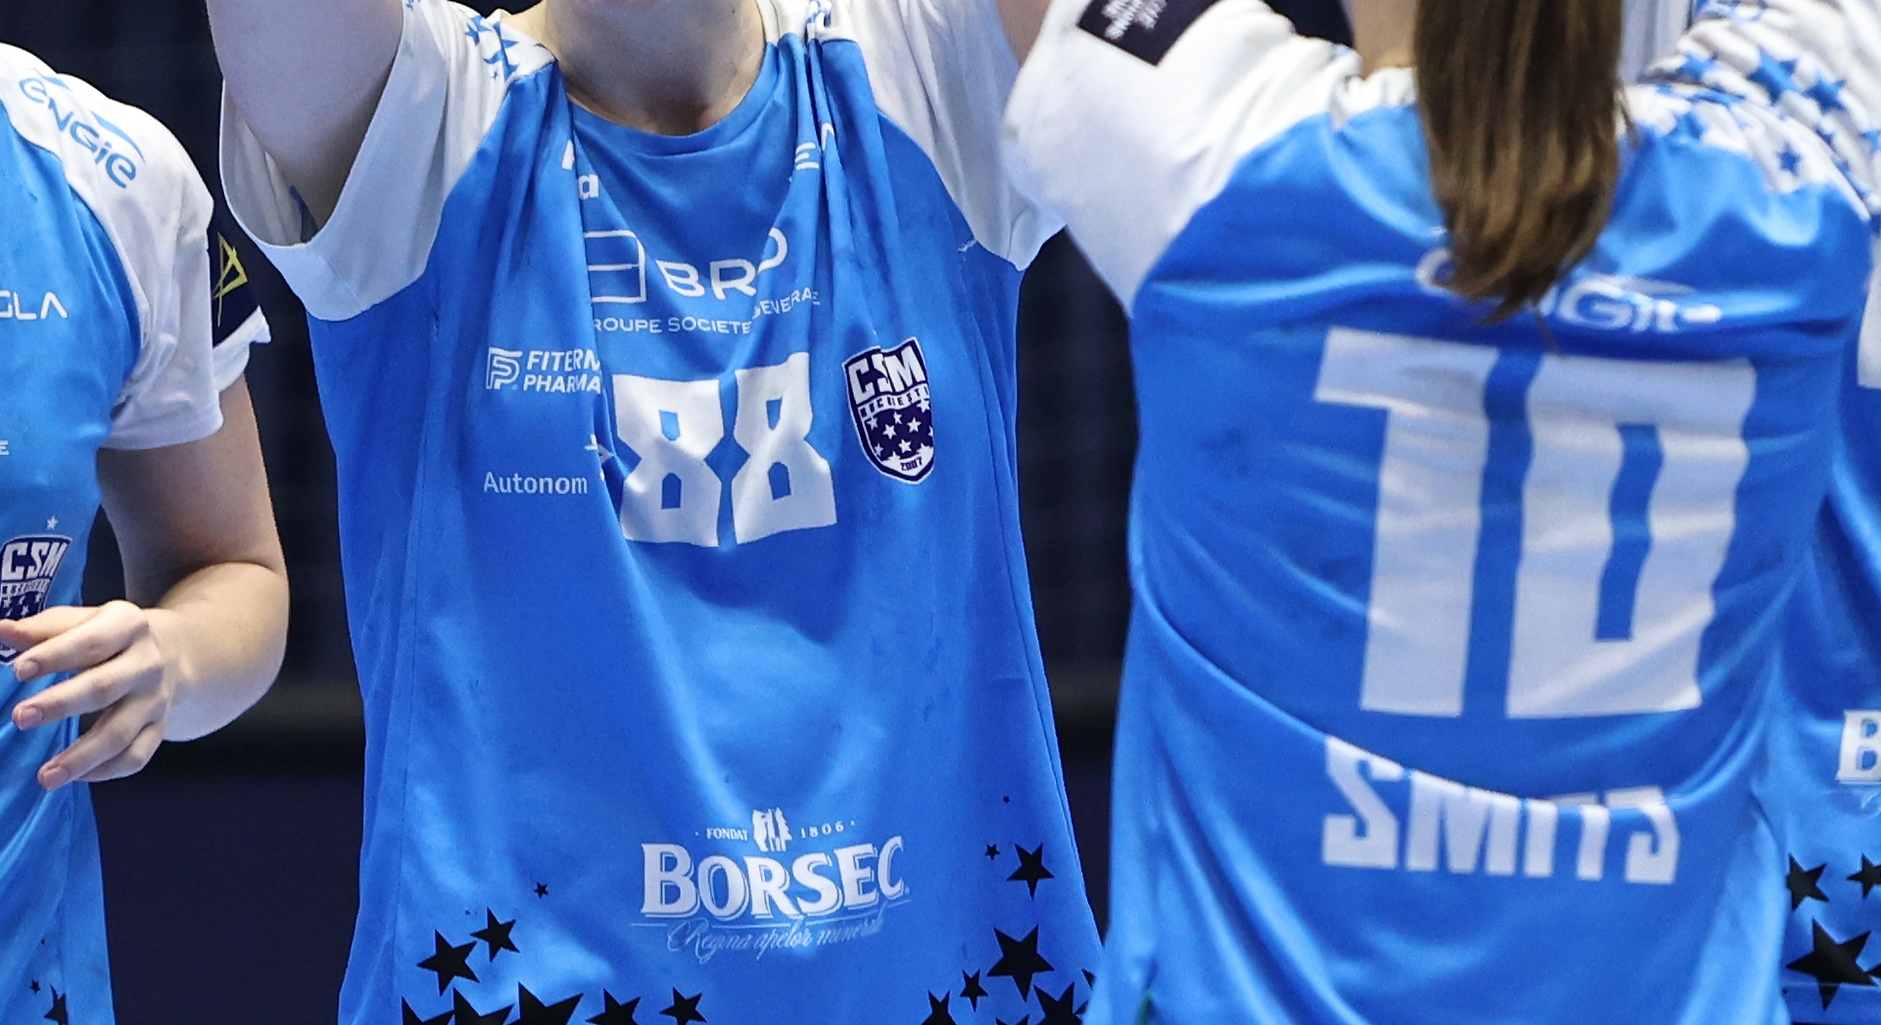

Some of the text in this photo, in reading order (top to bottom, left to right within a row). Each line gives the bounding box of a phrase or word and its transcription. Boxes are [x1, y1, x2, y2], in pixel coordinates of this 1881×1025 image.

[668, 317, 752, 334] SOCIETE
[523, 374, 601, 395] PHARMA
[848, 345, 926, 405] CSM
[612, 352, 838, 547] 88
[484, 472, 588, 495] Autonom
[1314, 326, 1756, 719] 10
[706, 820, 845, 842] FONDAT 1806
[640, 836, 906, 920] BORSEC
